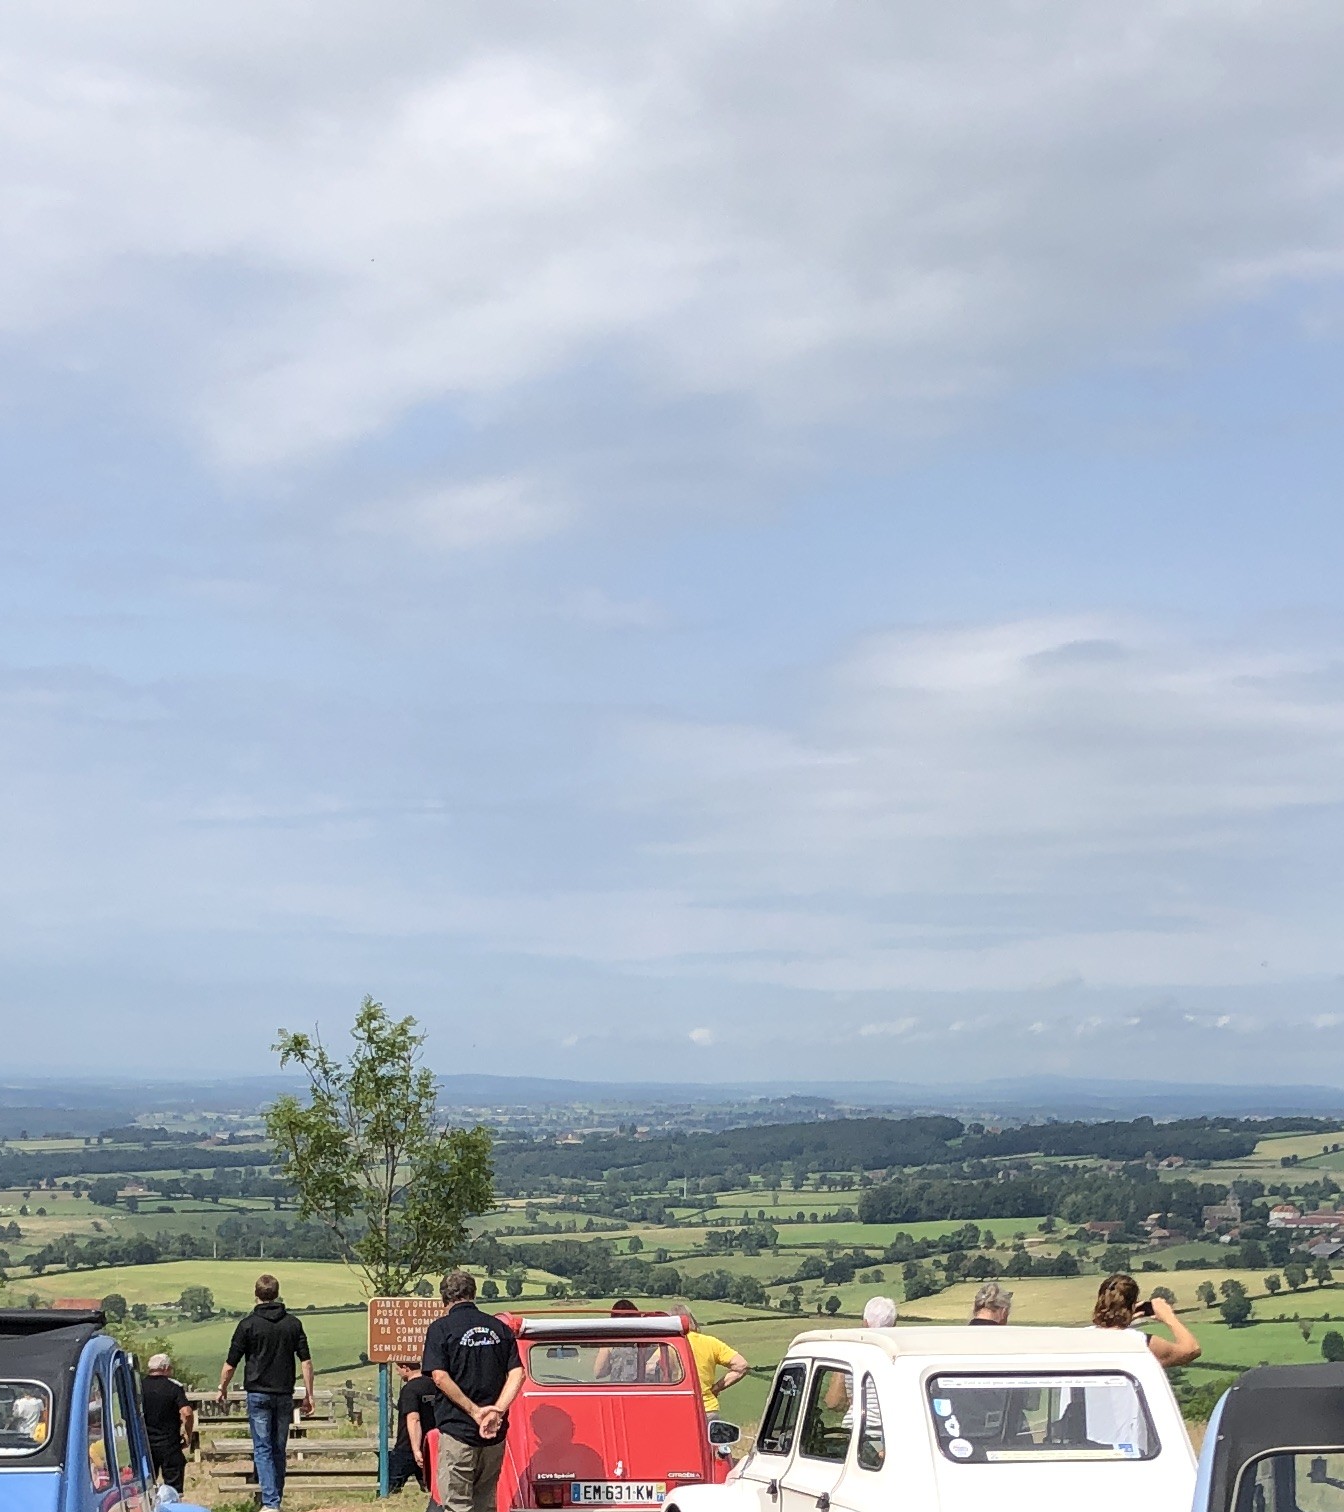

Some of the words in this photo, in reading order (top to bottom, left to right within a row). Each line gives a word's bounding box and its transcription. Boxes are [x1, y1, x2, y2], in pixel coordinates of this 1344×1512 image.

[376, 1300, 400, 1308] TABLE
[407, 1309, 418, 1317] LE
[380, 1326, 391, 1334] DE
[373, 1344, 403, 1352] SEMUR
[407, 1344, 418, 1352] EN
[386, 1353, 422, 1361] Altitude
[583, 1485, 654, 1500] EM-631-KW
